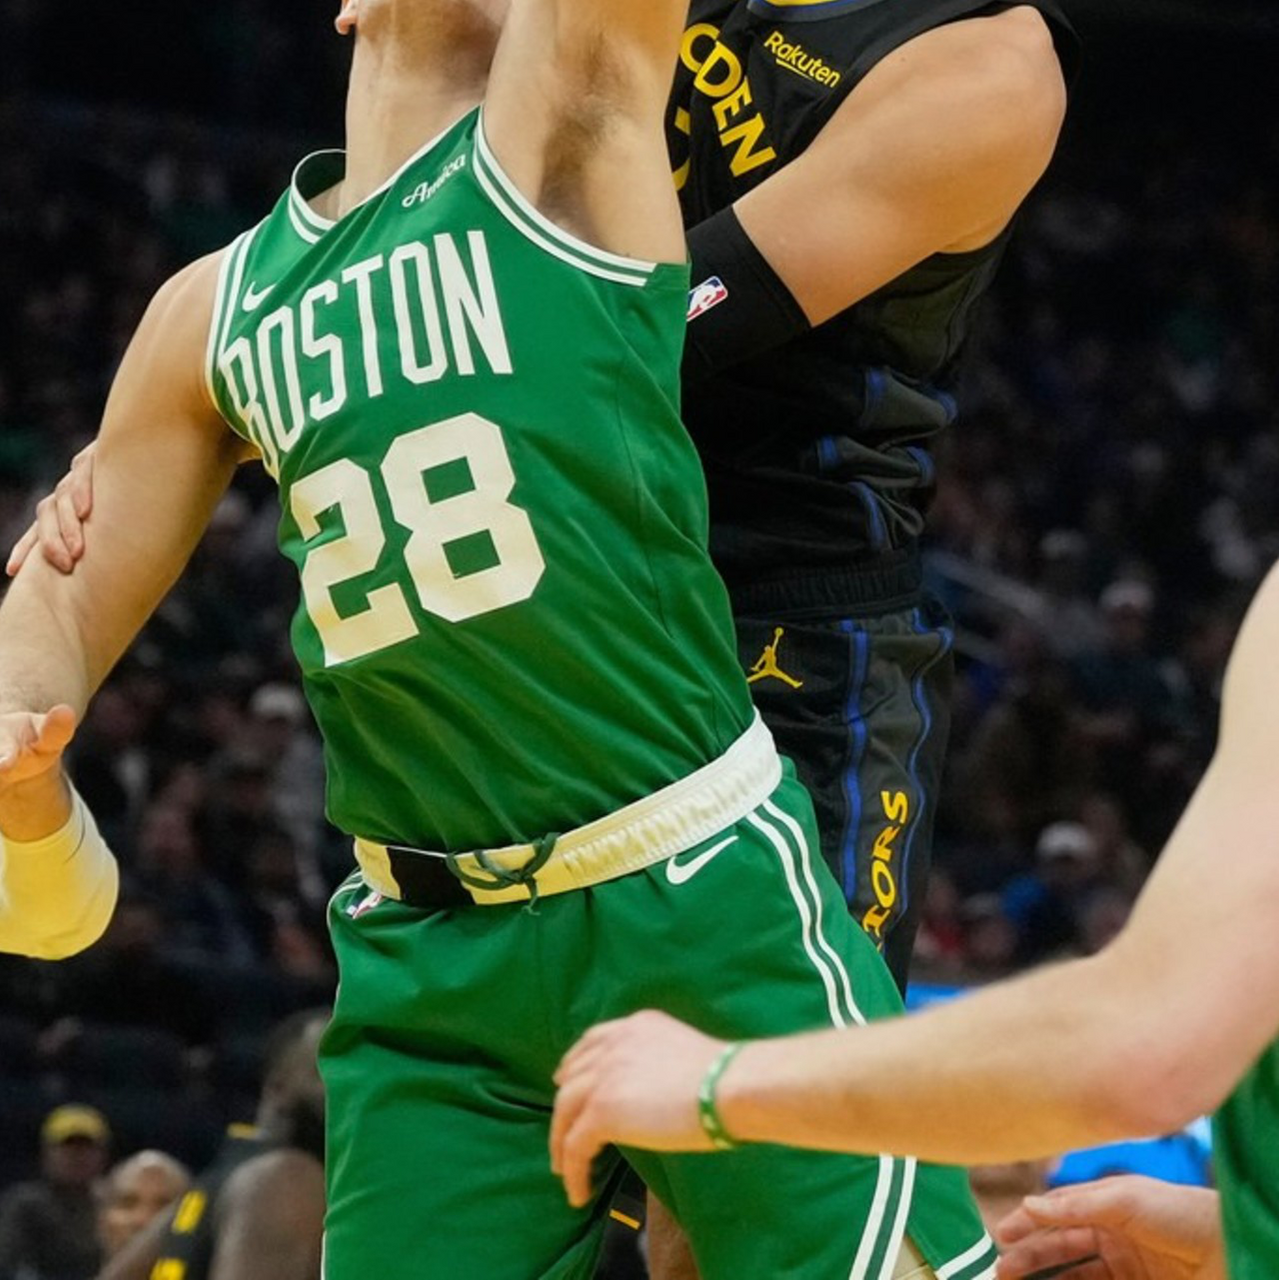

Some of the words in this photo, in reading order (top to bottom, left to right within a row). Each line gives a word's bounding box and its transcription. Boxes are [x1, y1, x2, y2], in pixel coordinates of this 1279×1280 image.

[763, 31, 840, 88] Rakuten
[402, 154, 466, 208] Amica
[219, 230, 513, 484] BOSTON
[291, 412, 545, 667] 28
